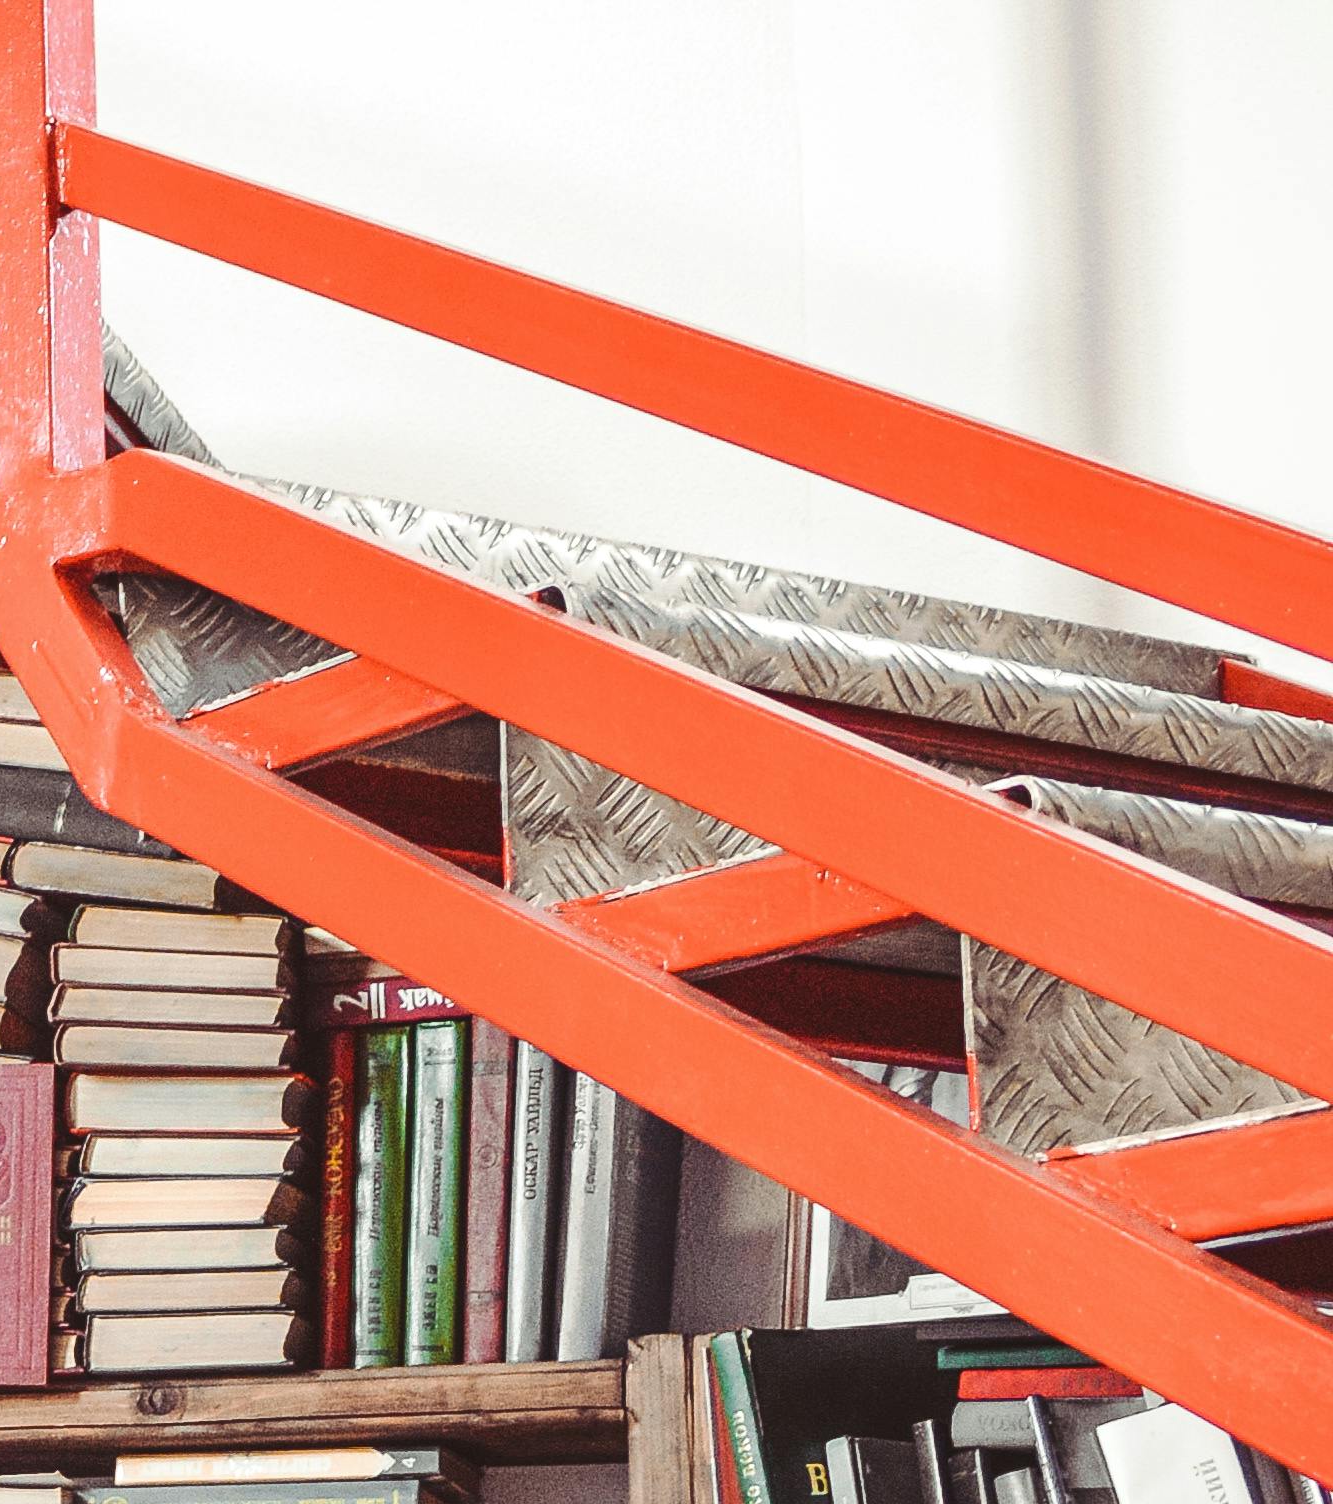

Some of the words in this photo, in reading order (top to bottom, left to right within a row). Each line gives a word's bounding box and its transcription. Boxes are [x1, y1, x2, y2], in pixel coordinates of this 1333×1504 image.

[526, 1067, 543, 1134] УАЙЛЬД
[524, 1142, 539, 1200] ОСКАР
[805, 1462, 828, 1497] В
